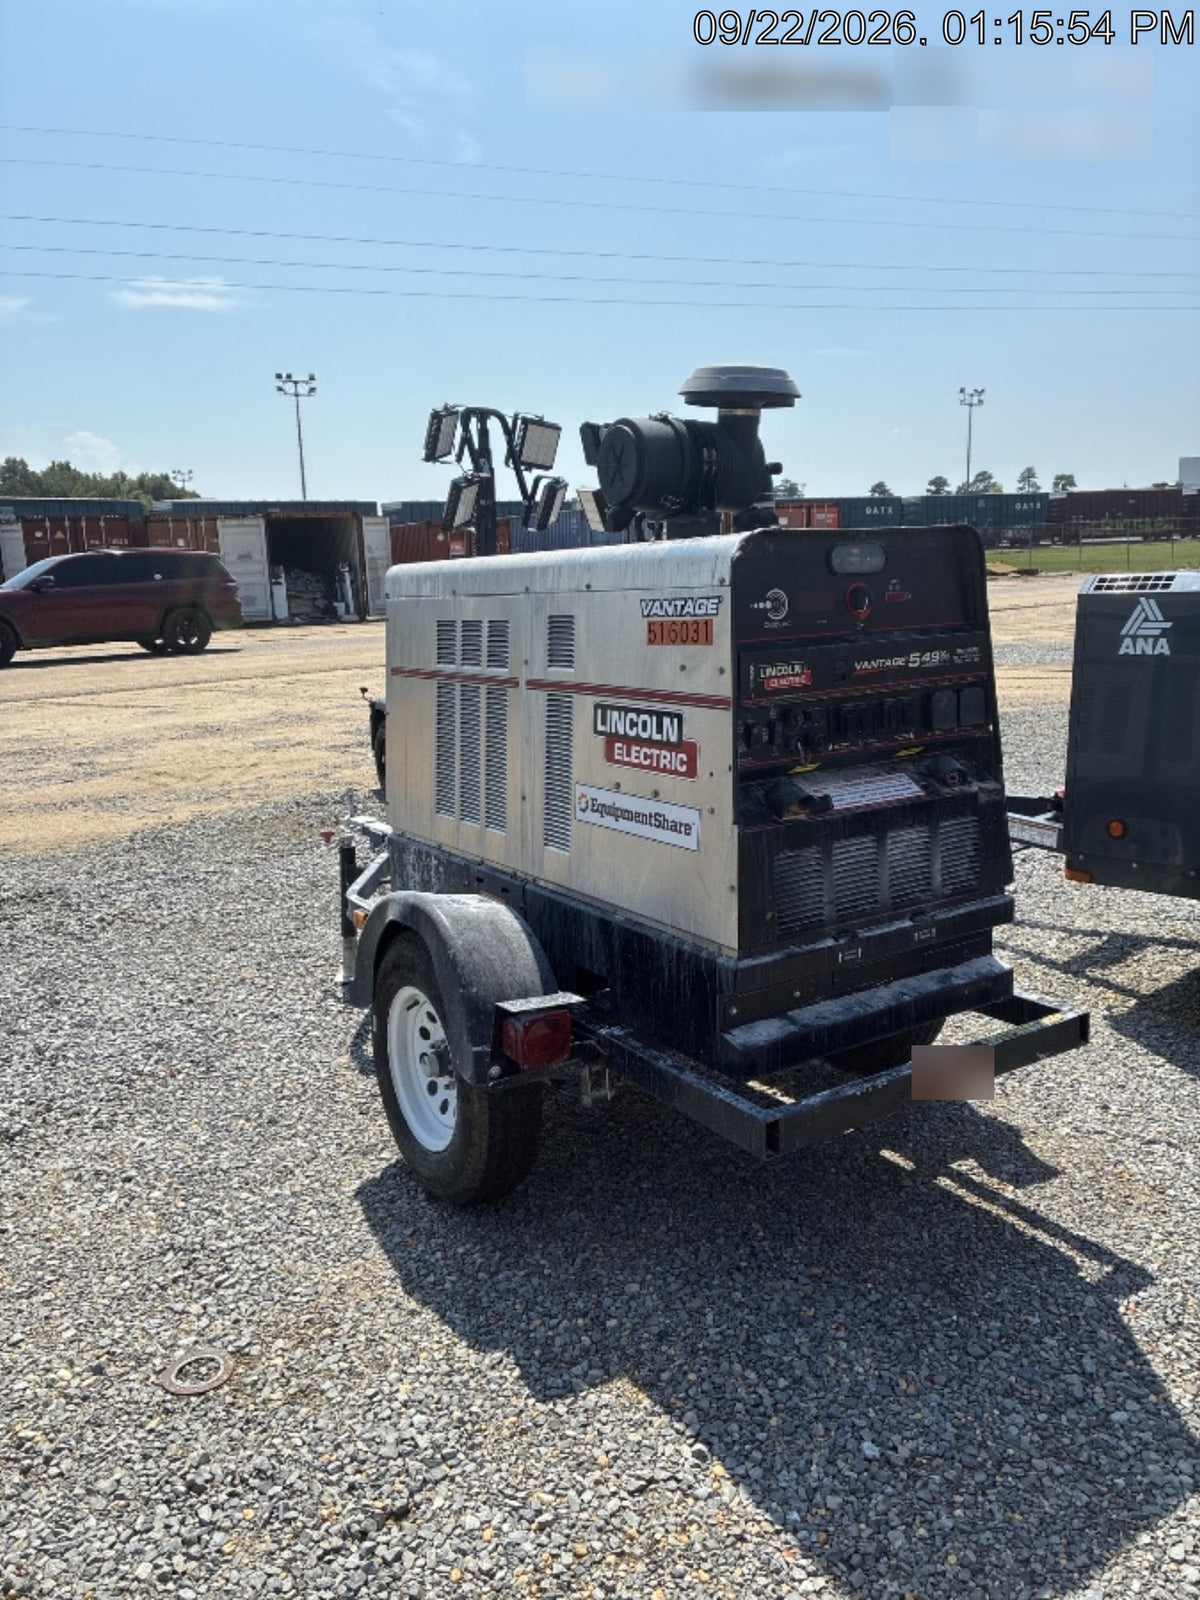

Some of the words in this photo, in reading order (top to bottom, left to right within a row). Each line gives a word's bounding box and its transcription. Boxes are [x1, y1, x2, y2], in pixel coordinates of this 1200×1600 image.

[641, 597, 720, 617] VANTAGE
[648, 620, 711, 645] 516031
[1118, 637, 1171, 656] ANA
[760, 664, 803, 678] LINCOLN
[854, 656, 906, 671] VANTAGE
[596, 707, 679, 744] LINCOLN
[613, 742, 688, 773] ELECTRIC
[590, 797, 692, 836] EquipmentShare
